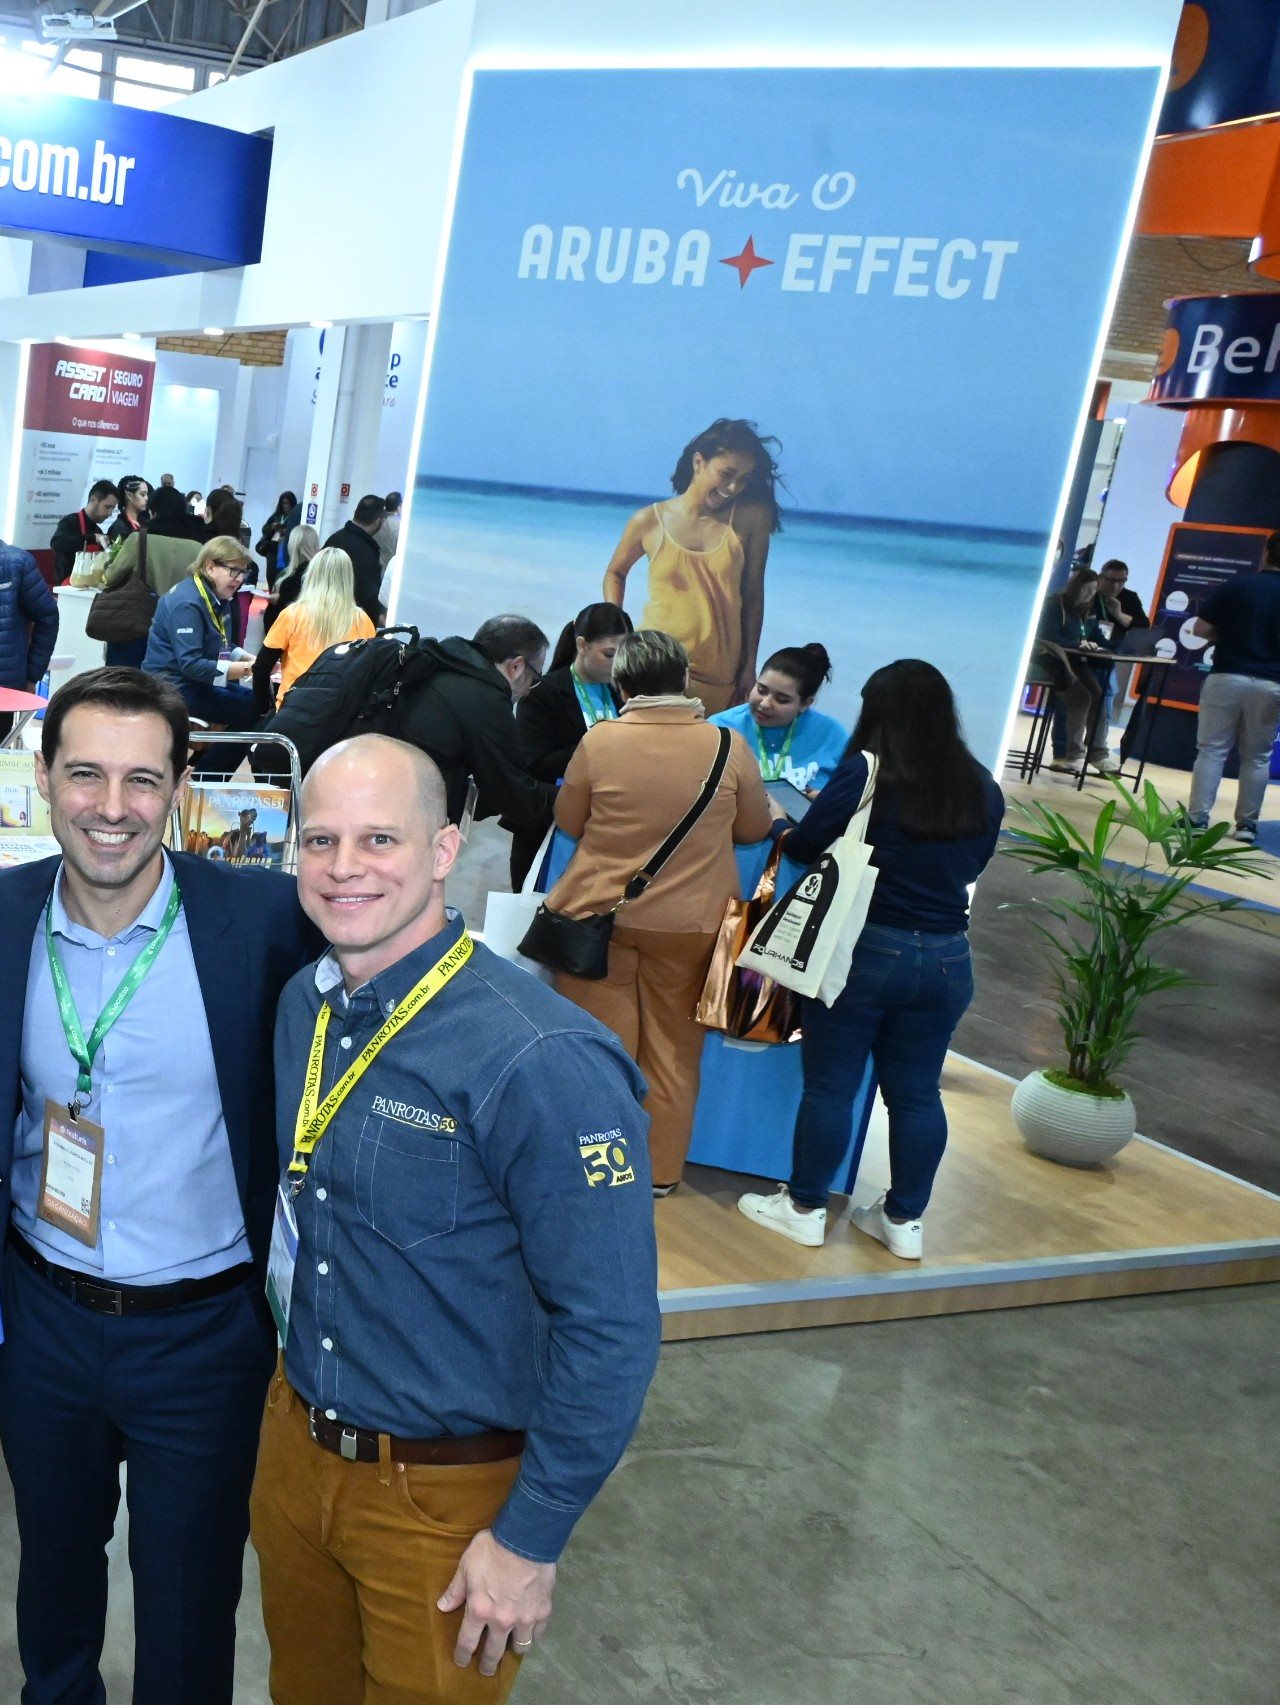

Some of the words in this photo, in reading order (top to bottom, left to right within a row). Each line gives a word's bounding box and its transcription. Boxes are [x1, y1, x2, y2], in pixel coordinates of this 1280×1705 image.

[677, 168, 800, 210] Viva
[812, 171, 856, 211] O
[517, 223, 711, 287] ARUBA
[781, 233, 1019, 300] EFFECT
[55, 360, 107, 383] ASSIST
[114, 370, 143, 387] SEGURO
[69, 382, 107, 403] CARD
[112, 390, 139, 407] VIAGEM
[753, 943, 805, 969] FOURHANDS
[361, 984, 431, 1062] PANROTAS.com.br
[300, 1071, 356, 1144] PANROTAS.com.br
[371, 1095, 440, 1128] PANROTAS
[579, 1127, 622, 1145] PANROTAS
[580, 1138, 632, 1187] 50
[46, 1198, 87, 1227] ORGANIZAÇÃO
